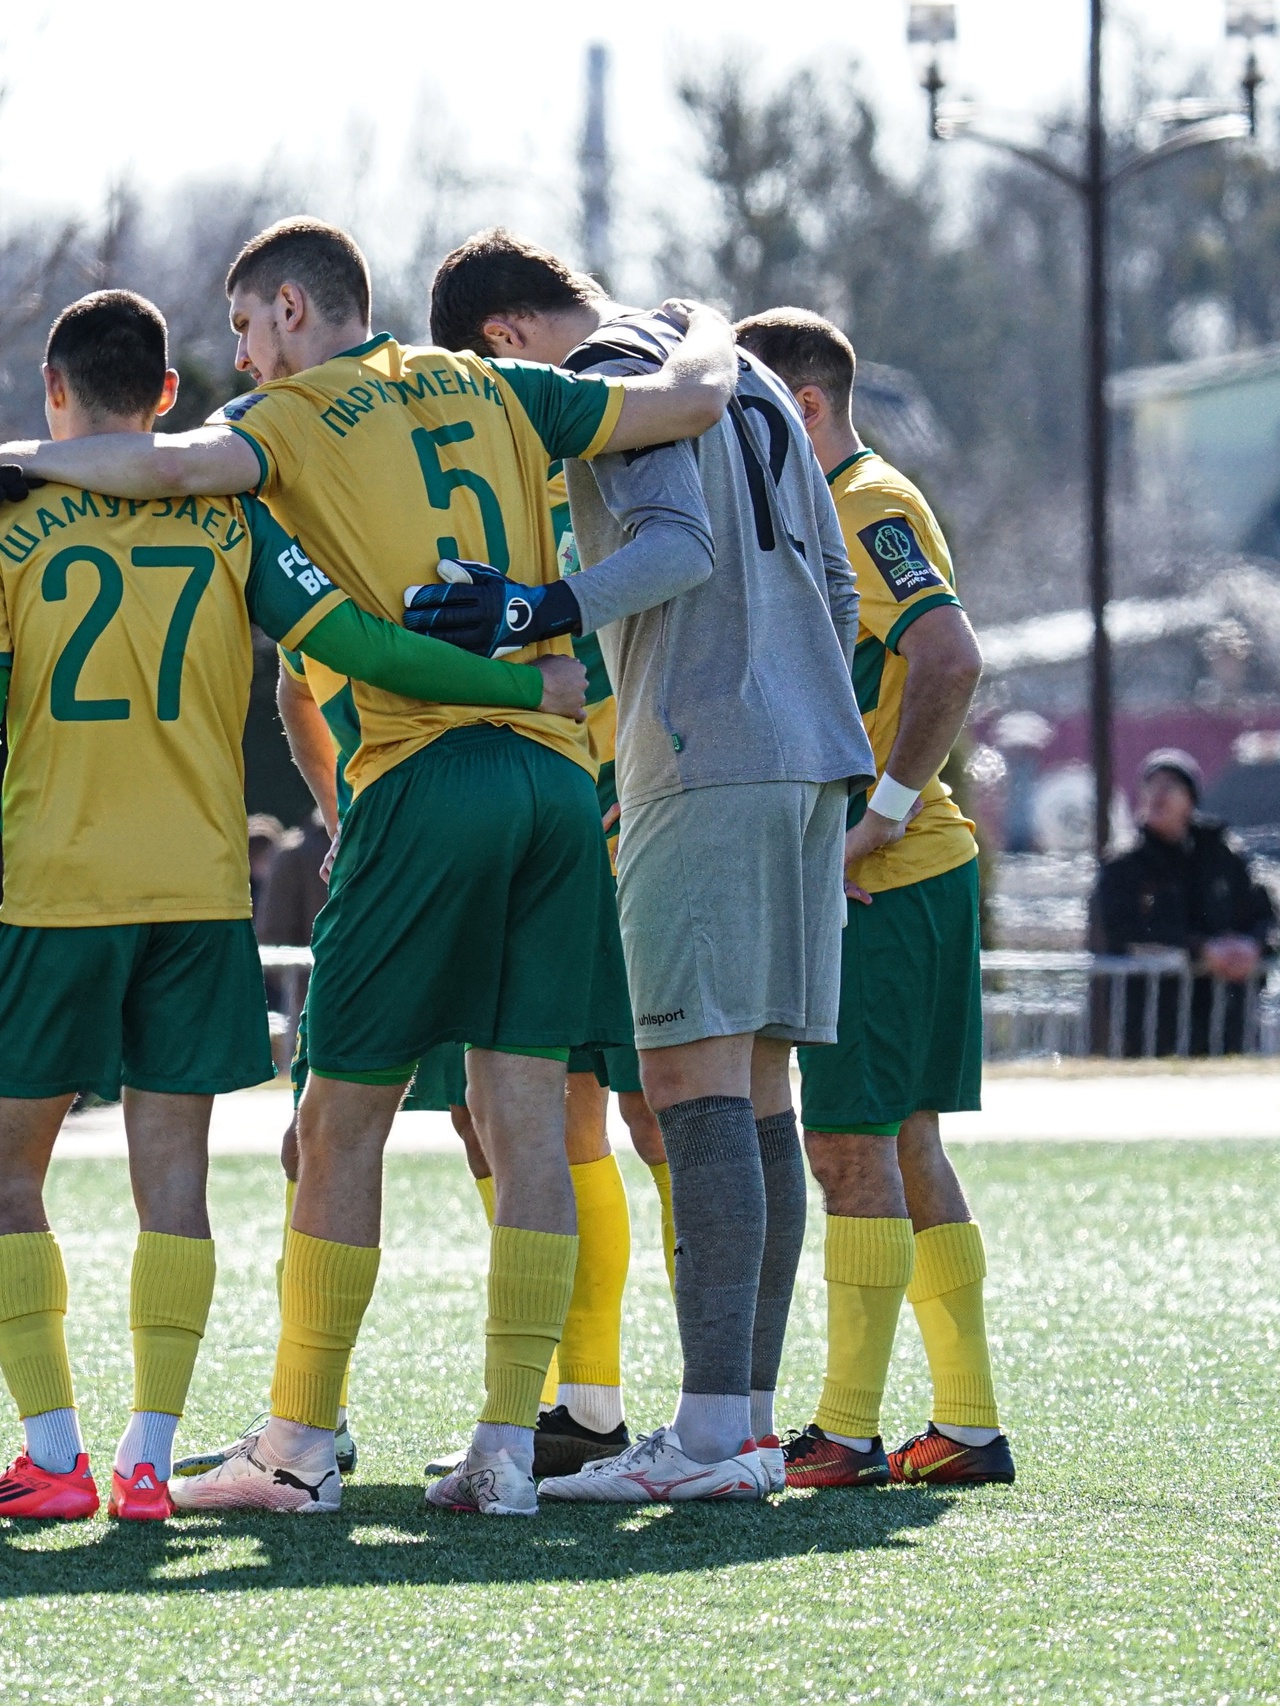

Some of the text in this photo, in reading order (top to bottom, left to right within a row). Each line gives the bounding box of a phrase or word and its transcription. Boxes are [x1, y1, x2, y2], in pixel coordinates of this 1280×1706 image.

[410, 420, 511, 576] 5
[277, 544, 310, 579] FO
[41, 545, 216, 722] 27
[638, 1007, 686, 1027] uhlsport
